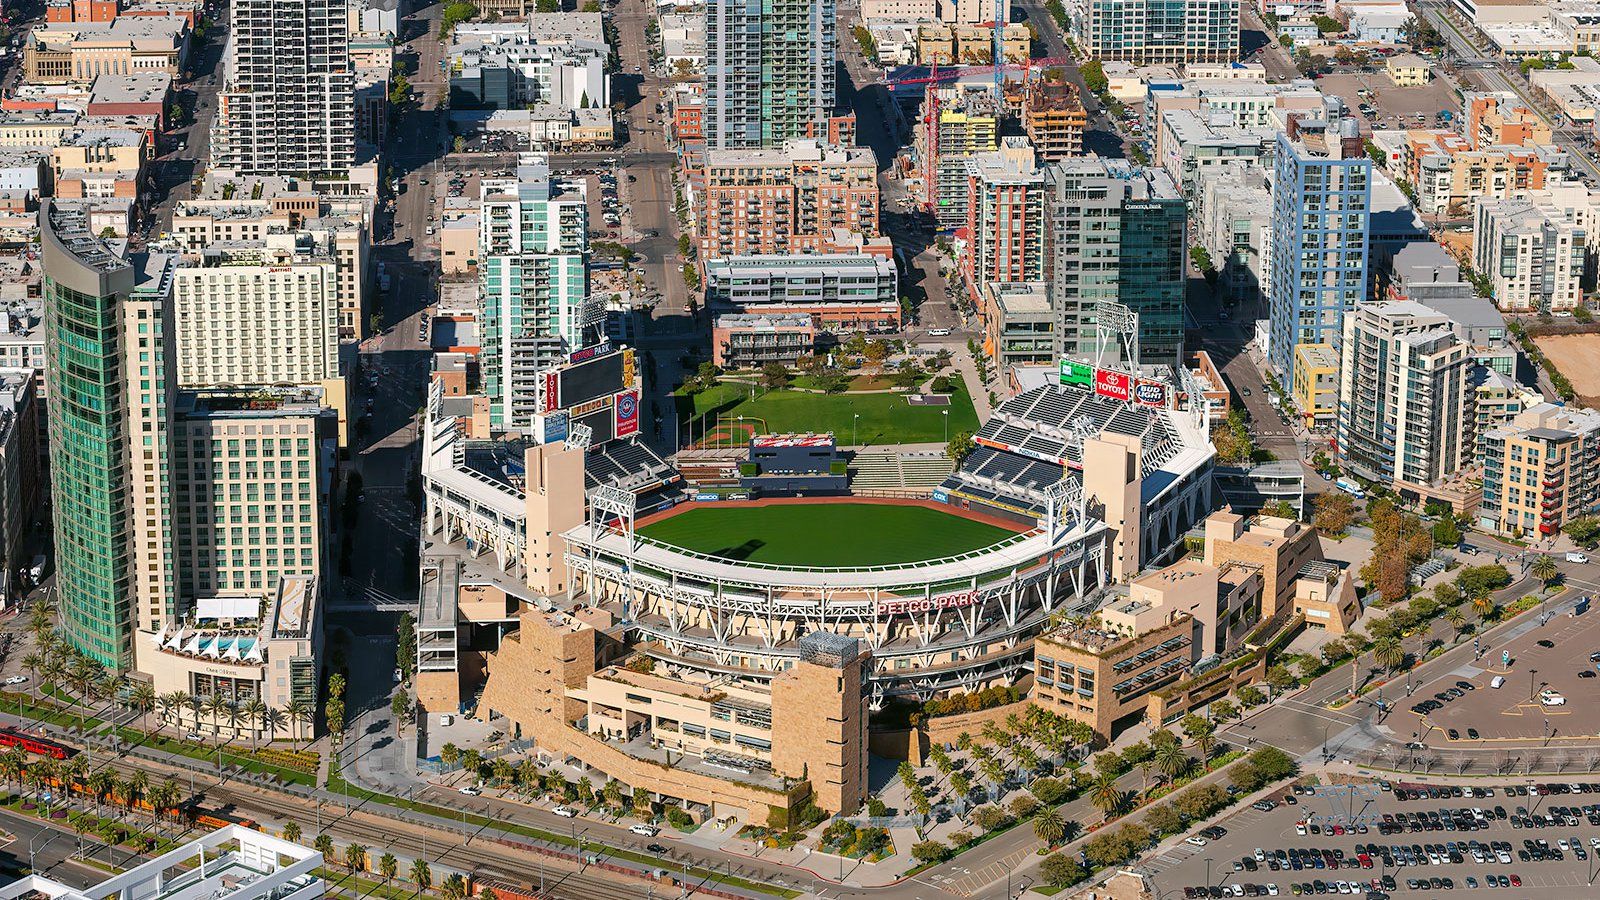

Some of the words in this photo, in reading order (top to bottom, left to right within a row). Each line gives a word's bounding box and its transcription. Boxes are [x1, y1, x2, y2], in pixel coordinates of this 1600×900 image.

[572, 348, 593, 361] PETCO
[594, 343, 610, 355] PARK
[1097, 381, 1127, 396] TOYOTA
[1138, 391, 1162, 399] LIGHT
[1140, 385, 1160, 393] BUD
[576, 400, 602, 414] PETCO
[1018, 448, 1040, 458] NOKIA
[877, 600, 931, 615] PETCO
[937, 591, 980, 609] PARK
